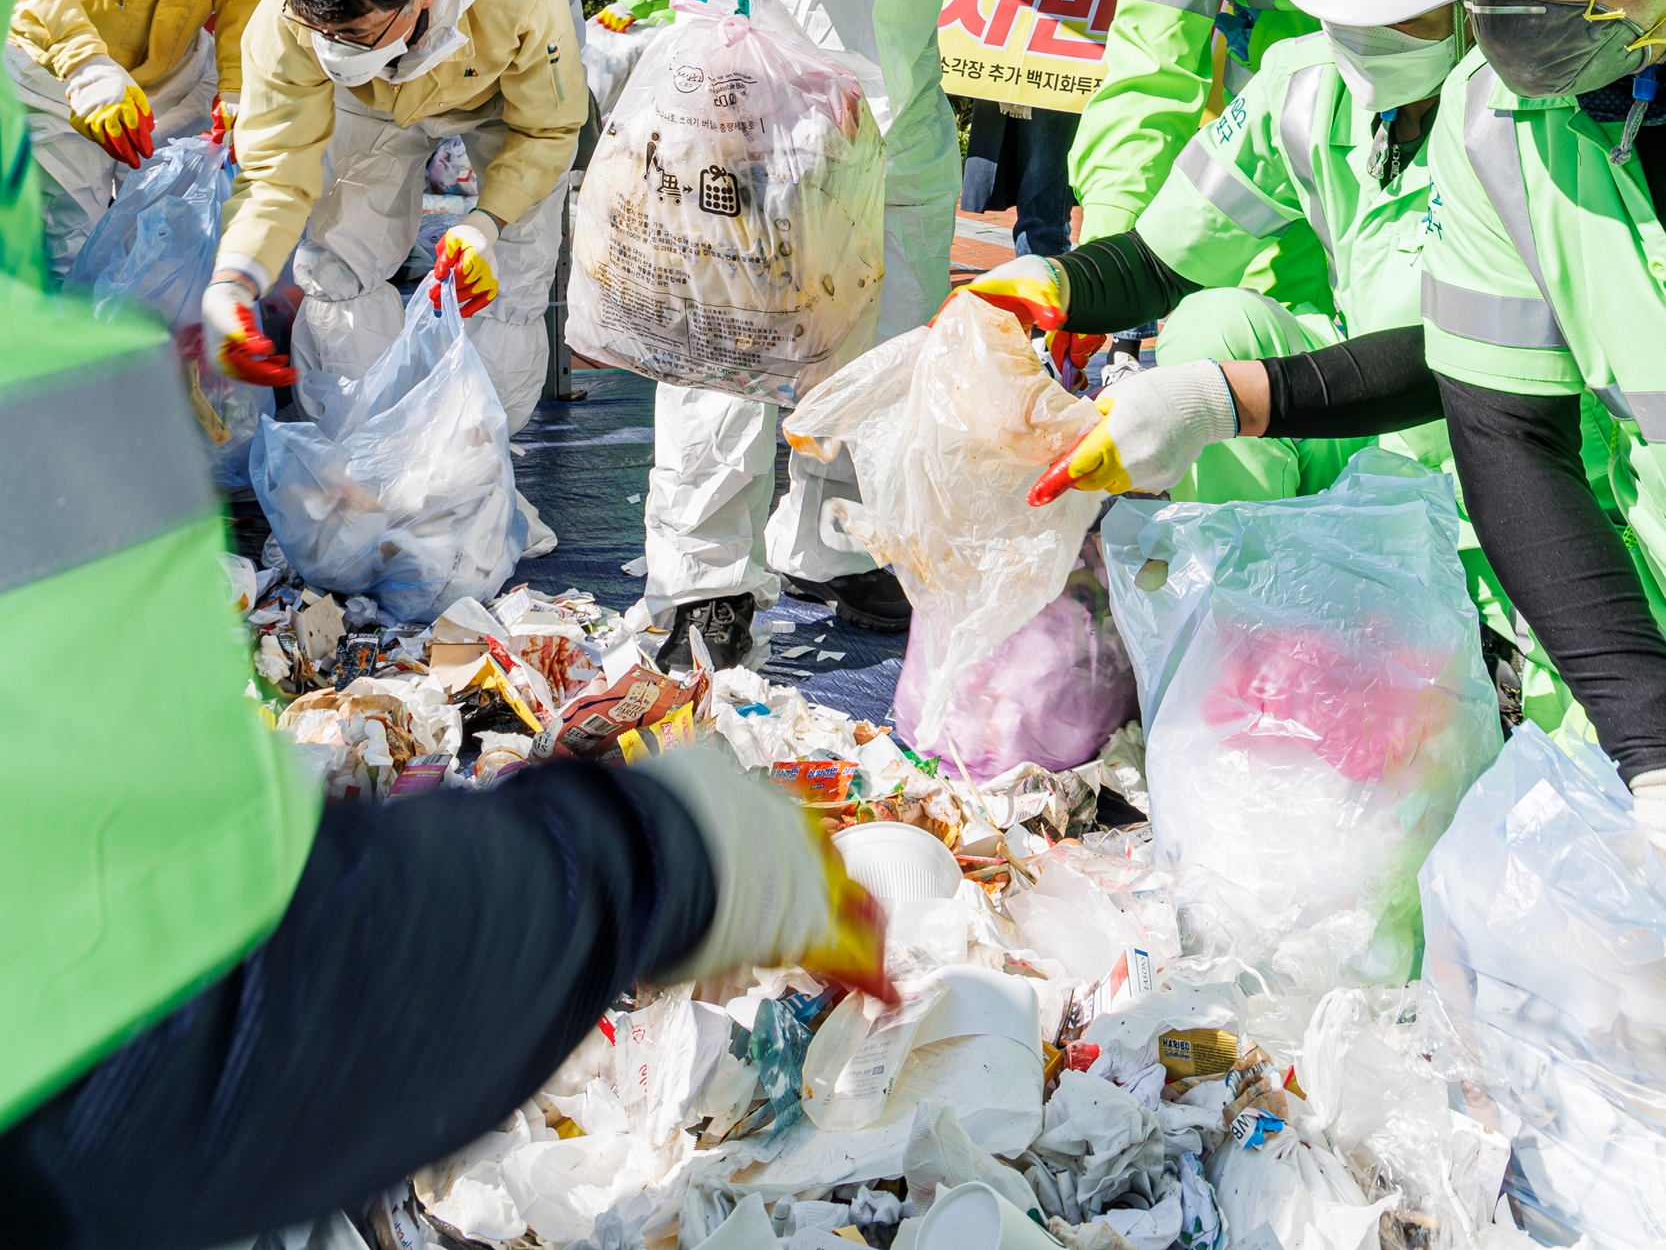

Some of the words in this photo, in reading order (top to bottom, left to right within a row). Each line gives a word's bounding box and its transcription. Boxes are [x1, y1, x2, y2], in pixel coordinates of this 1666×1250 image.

[988, 64, 1022, 85] 추가
[614, 705, 638, 719] PARIS
[620, 701, 646, 713] PETIT
[1141, 955, 1149, 993] EASONS
[1162, 1038, 1191, 1051] HARIBO
